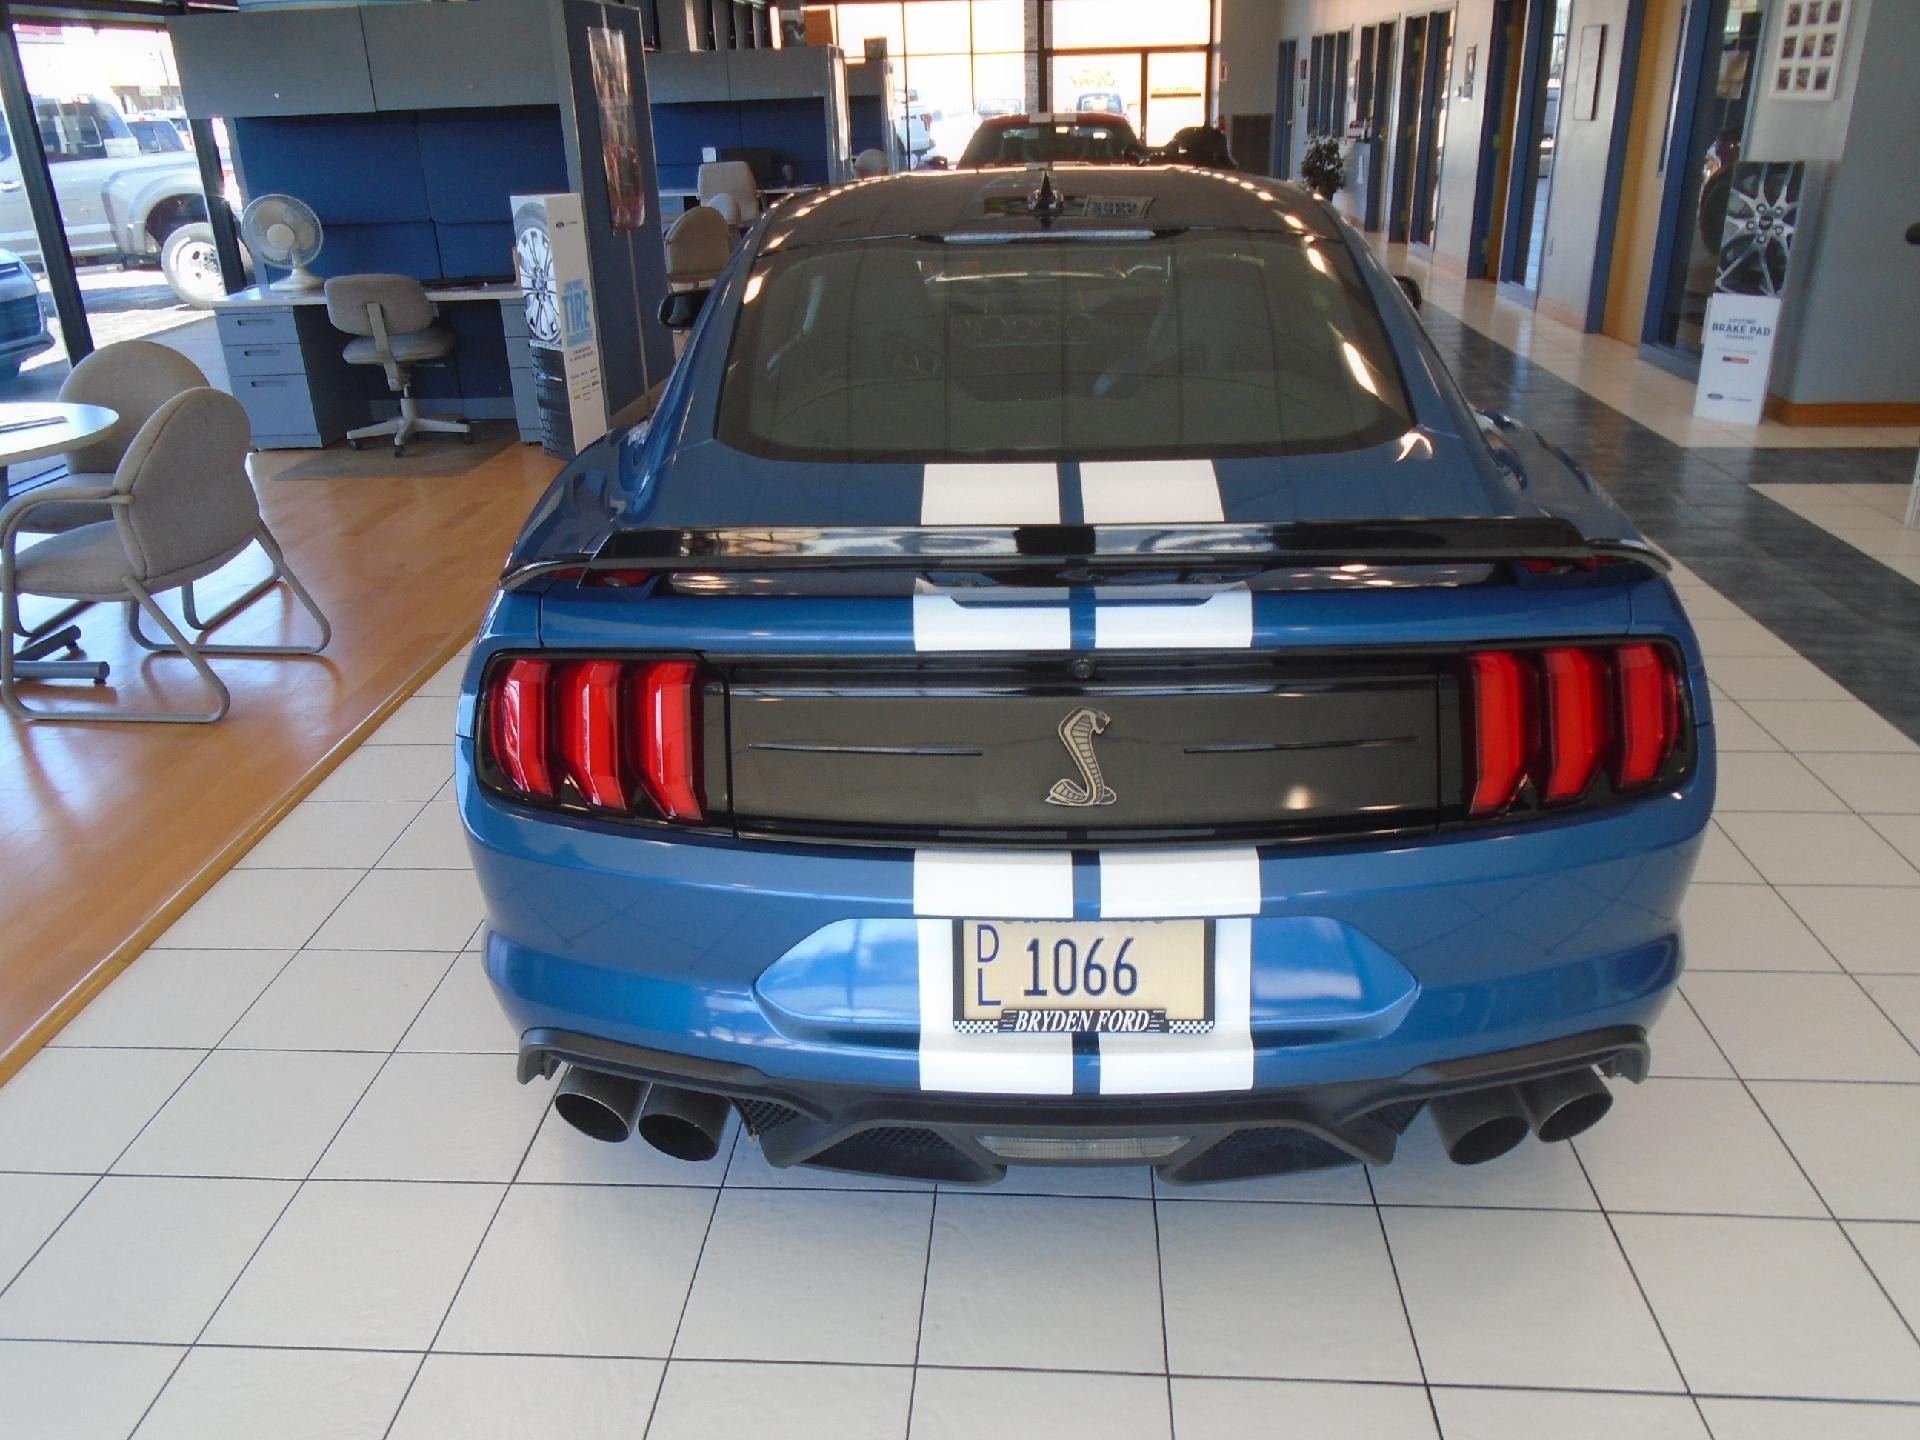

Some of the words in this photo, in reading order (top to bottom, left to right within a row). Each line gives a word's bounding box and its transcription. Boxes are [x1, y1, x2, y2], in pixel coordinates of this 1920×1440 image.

[563, 290, 592, 334] TIRE
[1711, 322, 1746, 334] BRAKE
[1750, 325, 1771, 337] PAD
[1023, 936, 1138, 997] 1066
[1014, 1009, 1093, 1032] BRYDEN
[1095, 1009, 1151, 1032] FORD
